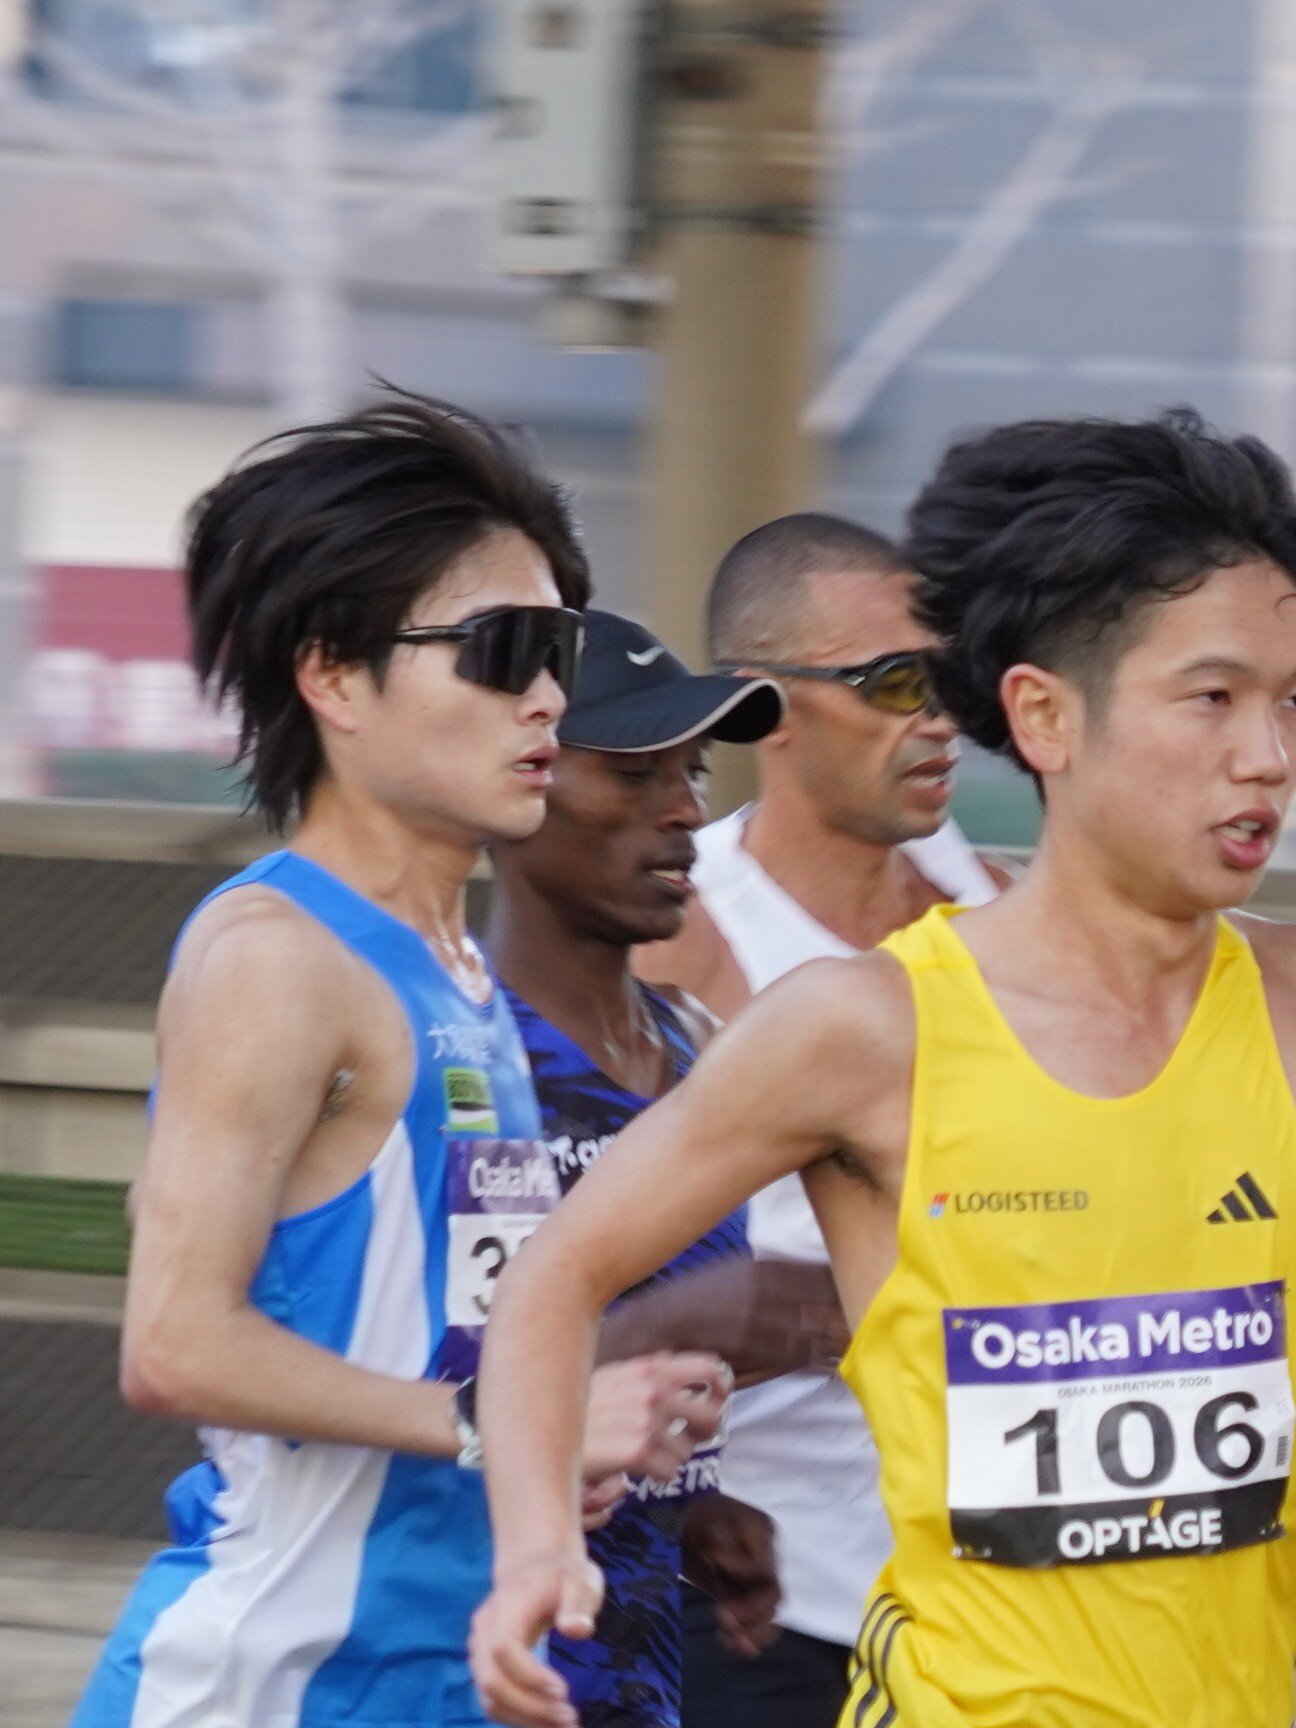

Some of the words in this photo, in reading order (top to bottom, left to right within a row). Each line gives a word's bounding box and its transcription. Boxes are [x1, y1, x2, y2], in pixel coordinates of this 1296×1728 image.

[956, 1189, 1090, 1215] LOGISTEED
[971, 1315, 1129, 1369] Osaka
[1138, 1307, 1274, 1358] Metro
[1058, 1386, 1098, 1398] OSAKA
[1102, 1380, 1175, 1394] MARATHON
[1179, 1376, 1213, 1388] 2026
[1004, 1391, 1265, 1497] 106
[1057, 1506, 1223, 1559] OPTAGE
